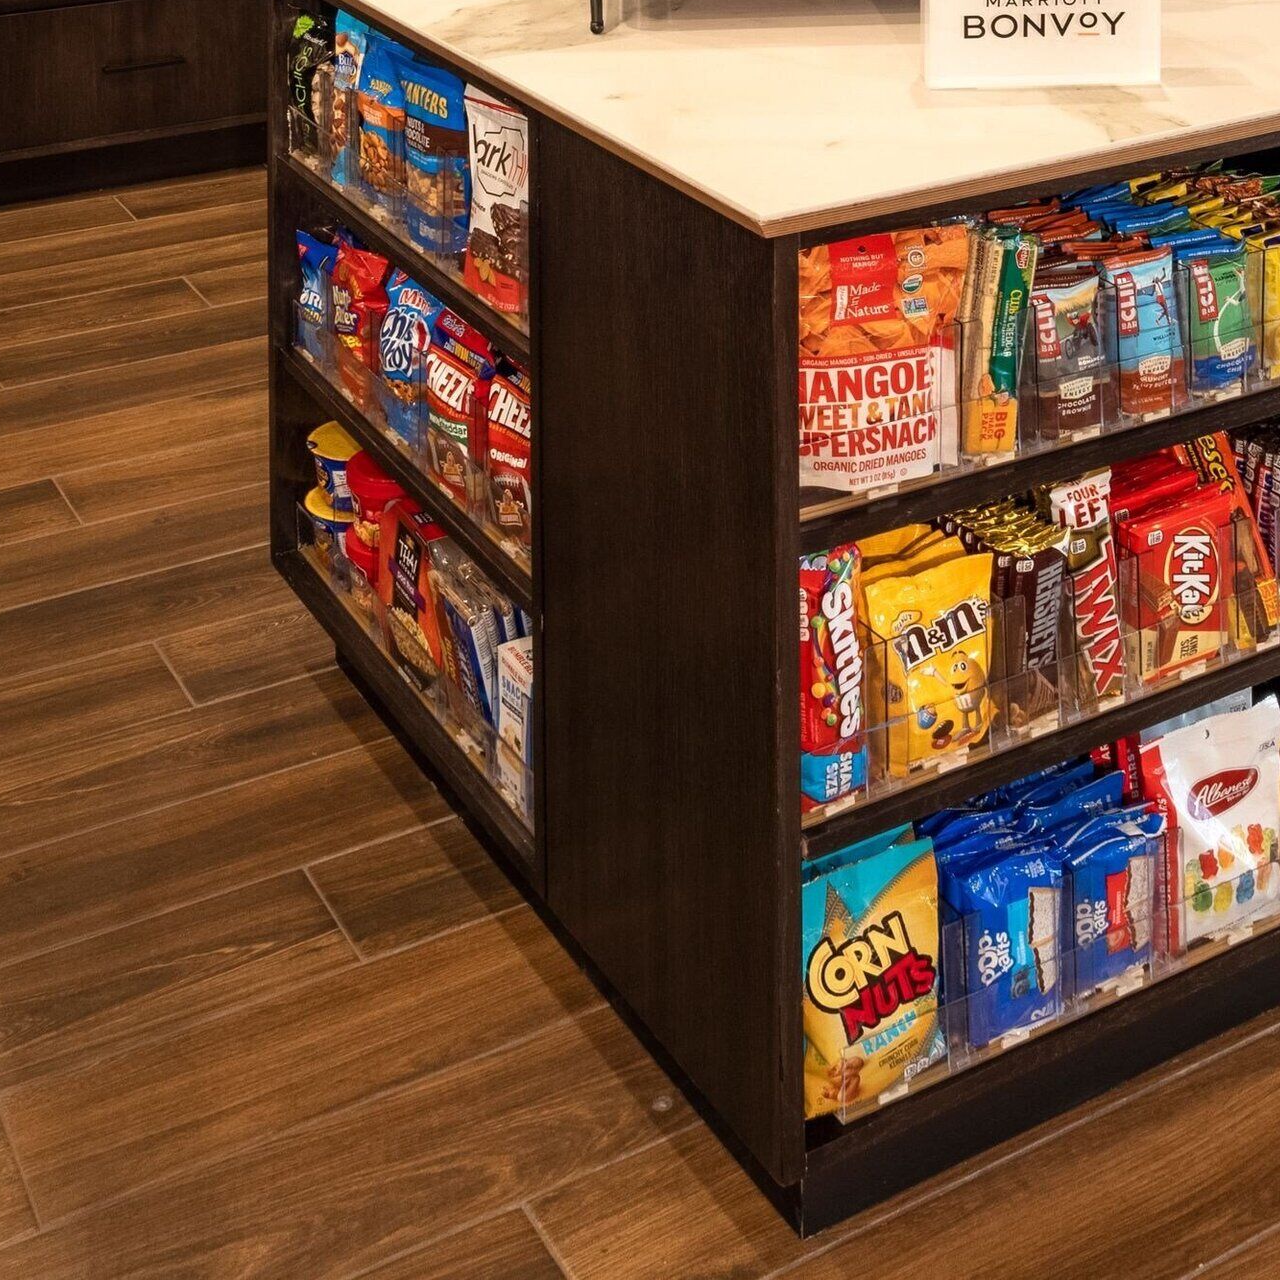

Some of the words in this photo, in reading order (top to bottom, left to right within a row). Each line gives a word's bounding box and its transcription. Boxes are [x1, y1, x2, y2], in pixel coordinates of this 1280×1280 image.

[963, 11, 1125, 39] BONVOY
[473, 124, 512, 176] bark
[849, 282, 881, 296] Made
[1117, 277, 1136, 321] CLIF
[1193, 265, 1214, 306] CLIF
[847, 304, 889, 318] Nature
[1031, 297, 1057, 343] CLIF
[1121, 321, 1137, 330] BAR
[866, 401, 883, 425] &
[1058, 395, 1096, 409] CHOCOLATE
[994, 411, 1008, 439] BIG
[813, 461, 857, 473] ORGANIC
[859, 457, 884, 472] DRIED
[886, 449, 927, 466] MANGOES
[848, 477, 860, 485] NET
[861, 476, 869, 484] WT
[873, 474, 882, 483] OZ
[1067, 488, 1099, 503] FOUR
[1028, 561, 1063, 671] HERSHEY'S
[1074, 543, 1124, 695] TWIX
[822, 583, 862, 738] Skittles
[1179, 640, 1189, 659] SIZE
[1188, 635, 1198, 655] KING
[826, 762, 838, 798] SIZE
[1131, 752, 1140, 798] BEARS
[1196, 776, 1252, 816] Albanese
[1094, 900, 1109, 937] tarts
[809, 911, 911, 1009] CORN
[978, 929, 997, 985] pop
[996, 931, 1013, 974] tarts
[839, 956, 936, 1044] NUTS
